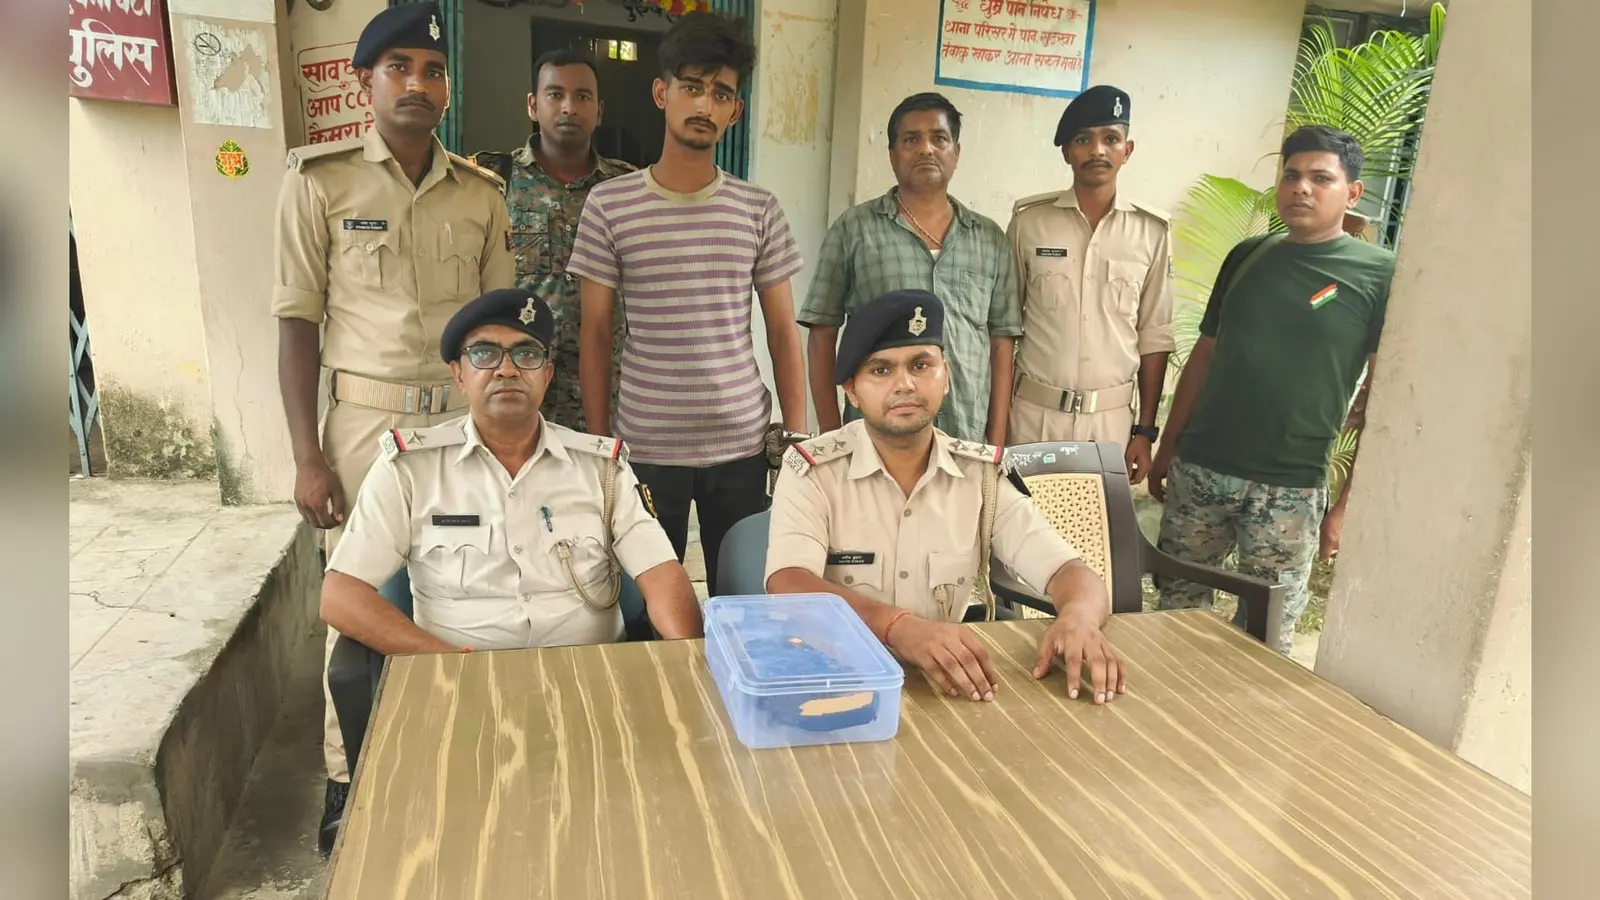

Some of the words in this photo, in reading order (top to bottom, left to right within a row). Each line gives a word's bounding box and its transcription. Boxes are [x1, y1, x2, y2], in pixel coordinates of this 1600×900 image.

[1006, 1, 1027, 17] पान
[945, 20, 971, 35] थाना
[974, 21, 1007, 42] परिसर
[1004, 50, 1033, 66] आना
[307, 94, 342, 118] आप
[216, 151, 244, 175] शुभ
